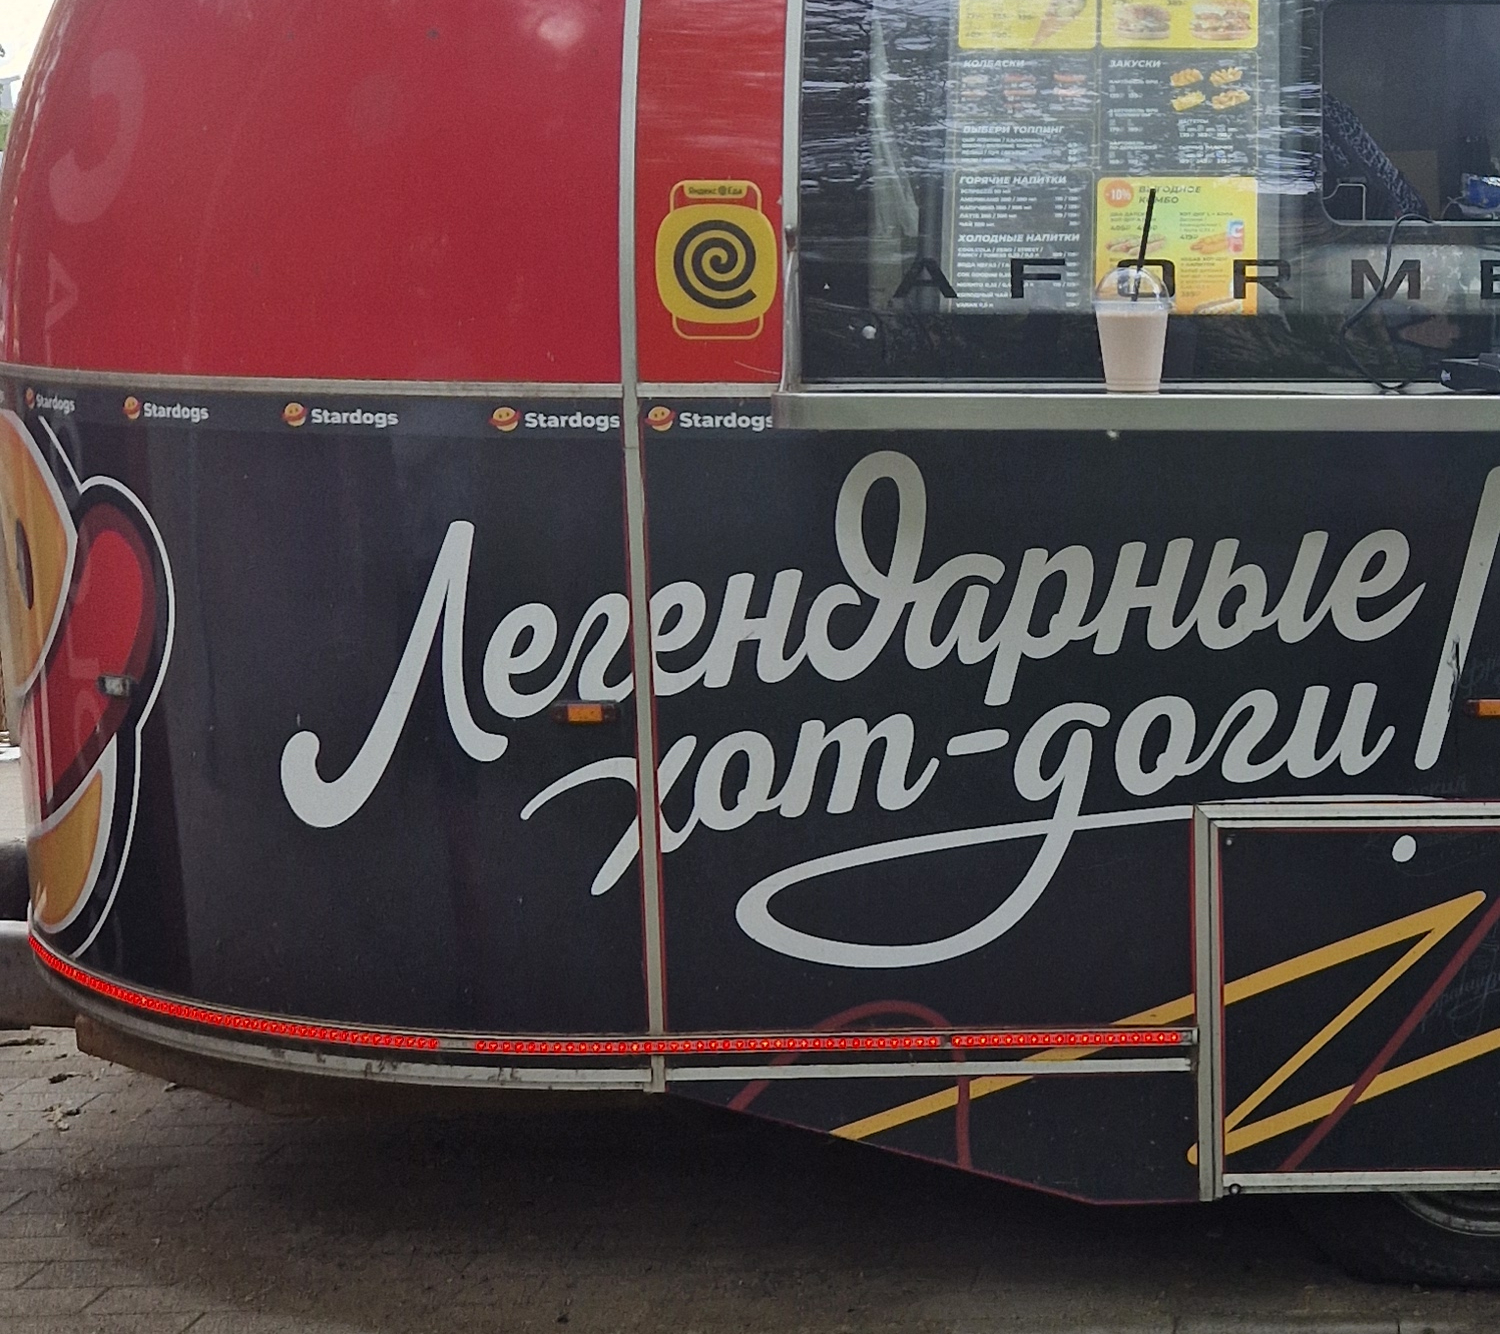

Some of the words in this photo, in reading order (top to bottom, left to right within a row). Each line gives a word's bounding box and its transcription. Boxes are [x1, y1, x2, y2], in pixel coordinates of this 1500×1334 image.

[964, 59, 1025, 68] КОЛБАСКИ
[1109, 59, 1161, 68] ЗАКУСКИ
[963, 126, 1010, 134] ВЫБЕРИ
[1013, 126, 1064, 134] ТОППИНГ
[960, 176, 1011, 185] ГОРЯЧИЕ
[1013, 176, 1068, 185] НАПИТКИ
[958, 234, 1024, 243] ХОЛОДНЫЕ
[1026, 234, 1080, 242] НАПИТКИ
[35, 393, 76, 413] Stardogs
[143, 402, 209, 423] Stardogs
[311, 408, 399, 429] Stardogs
[524, 411, 620, 432] Stardogs
[281, 450, 1426, 829] Легендарные
